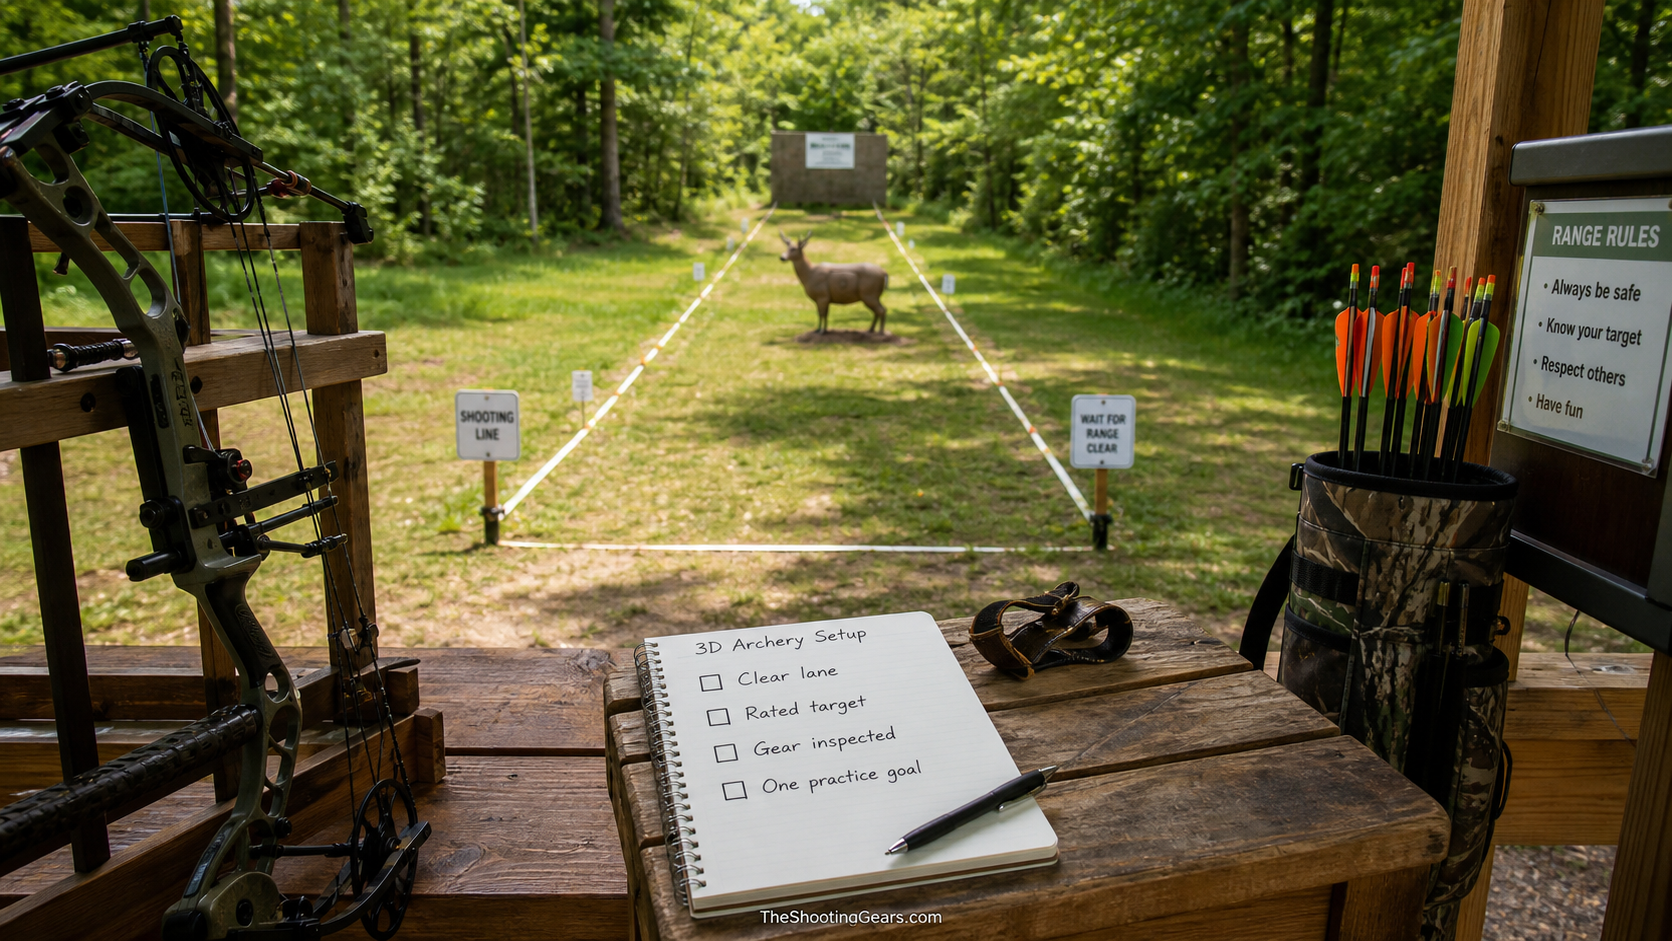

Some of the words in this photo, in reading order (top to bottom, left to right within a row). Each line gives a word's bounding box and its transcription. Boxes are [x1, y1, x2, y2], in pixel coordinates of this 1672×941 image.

[1552, 225, 1603, 247] RANGE
[1606, 225, 1661, 248] RULES
[1551, 279, 1592, 300] Always
[1595, 282, 1610, 299] be
[1613, 284, 1641, 302] safe
[1546, 318, 1576, 336] Know
[1577, 323, 1603, 341] your
[1605, 325, 1642, 347] target
[1541, 355, 1584, 379] Respect
[1587, 365, 1626, 387] others
[460, 410, 514, 424] SHOOTING
[1536, 393, 1562, 414] Have
[1565, 399, 1583, 419] fun
[1081, 414, 1104, 424] WAIT
[1107, 414, 1126, 425] FOR
[475, 428, 499, 441] LINE
[1086, 428, 1119, 439] RANGE
[1086, 443, 1118, 454] CLEAR
[695, 642, 722, 655] 3D
[732, 635, 804, 652] Archery
[815, 628, 867, 643] Setup
[738, 671, 790, 686] Clear
[801, 666, 839, 679] lane
[745, 702, 799, 720] Rated
[809, 695, 867, 715] target
[753, 741, 801, 756] Gear
[812, 725, 896, 751] inspected
[762, 778, 800, 794] One
[809, 769, 879, 794] practice
[888, 759, 922, 783] goal
